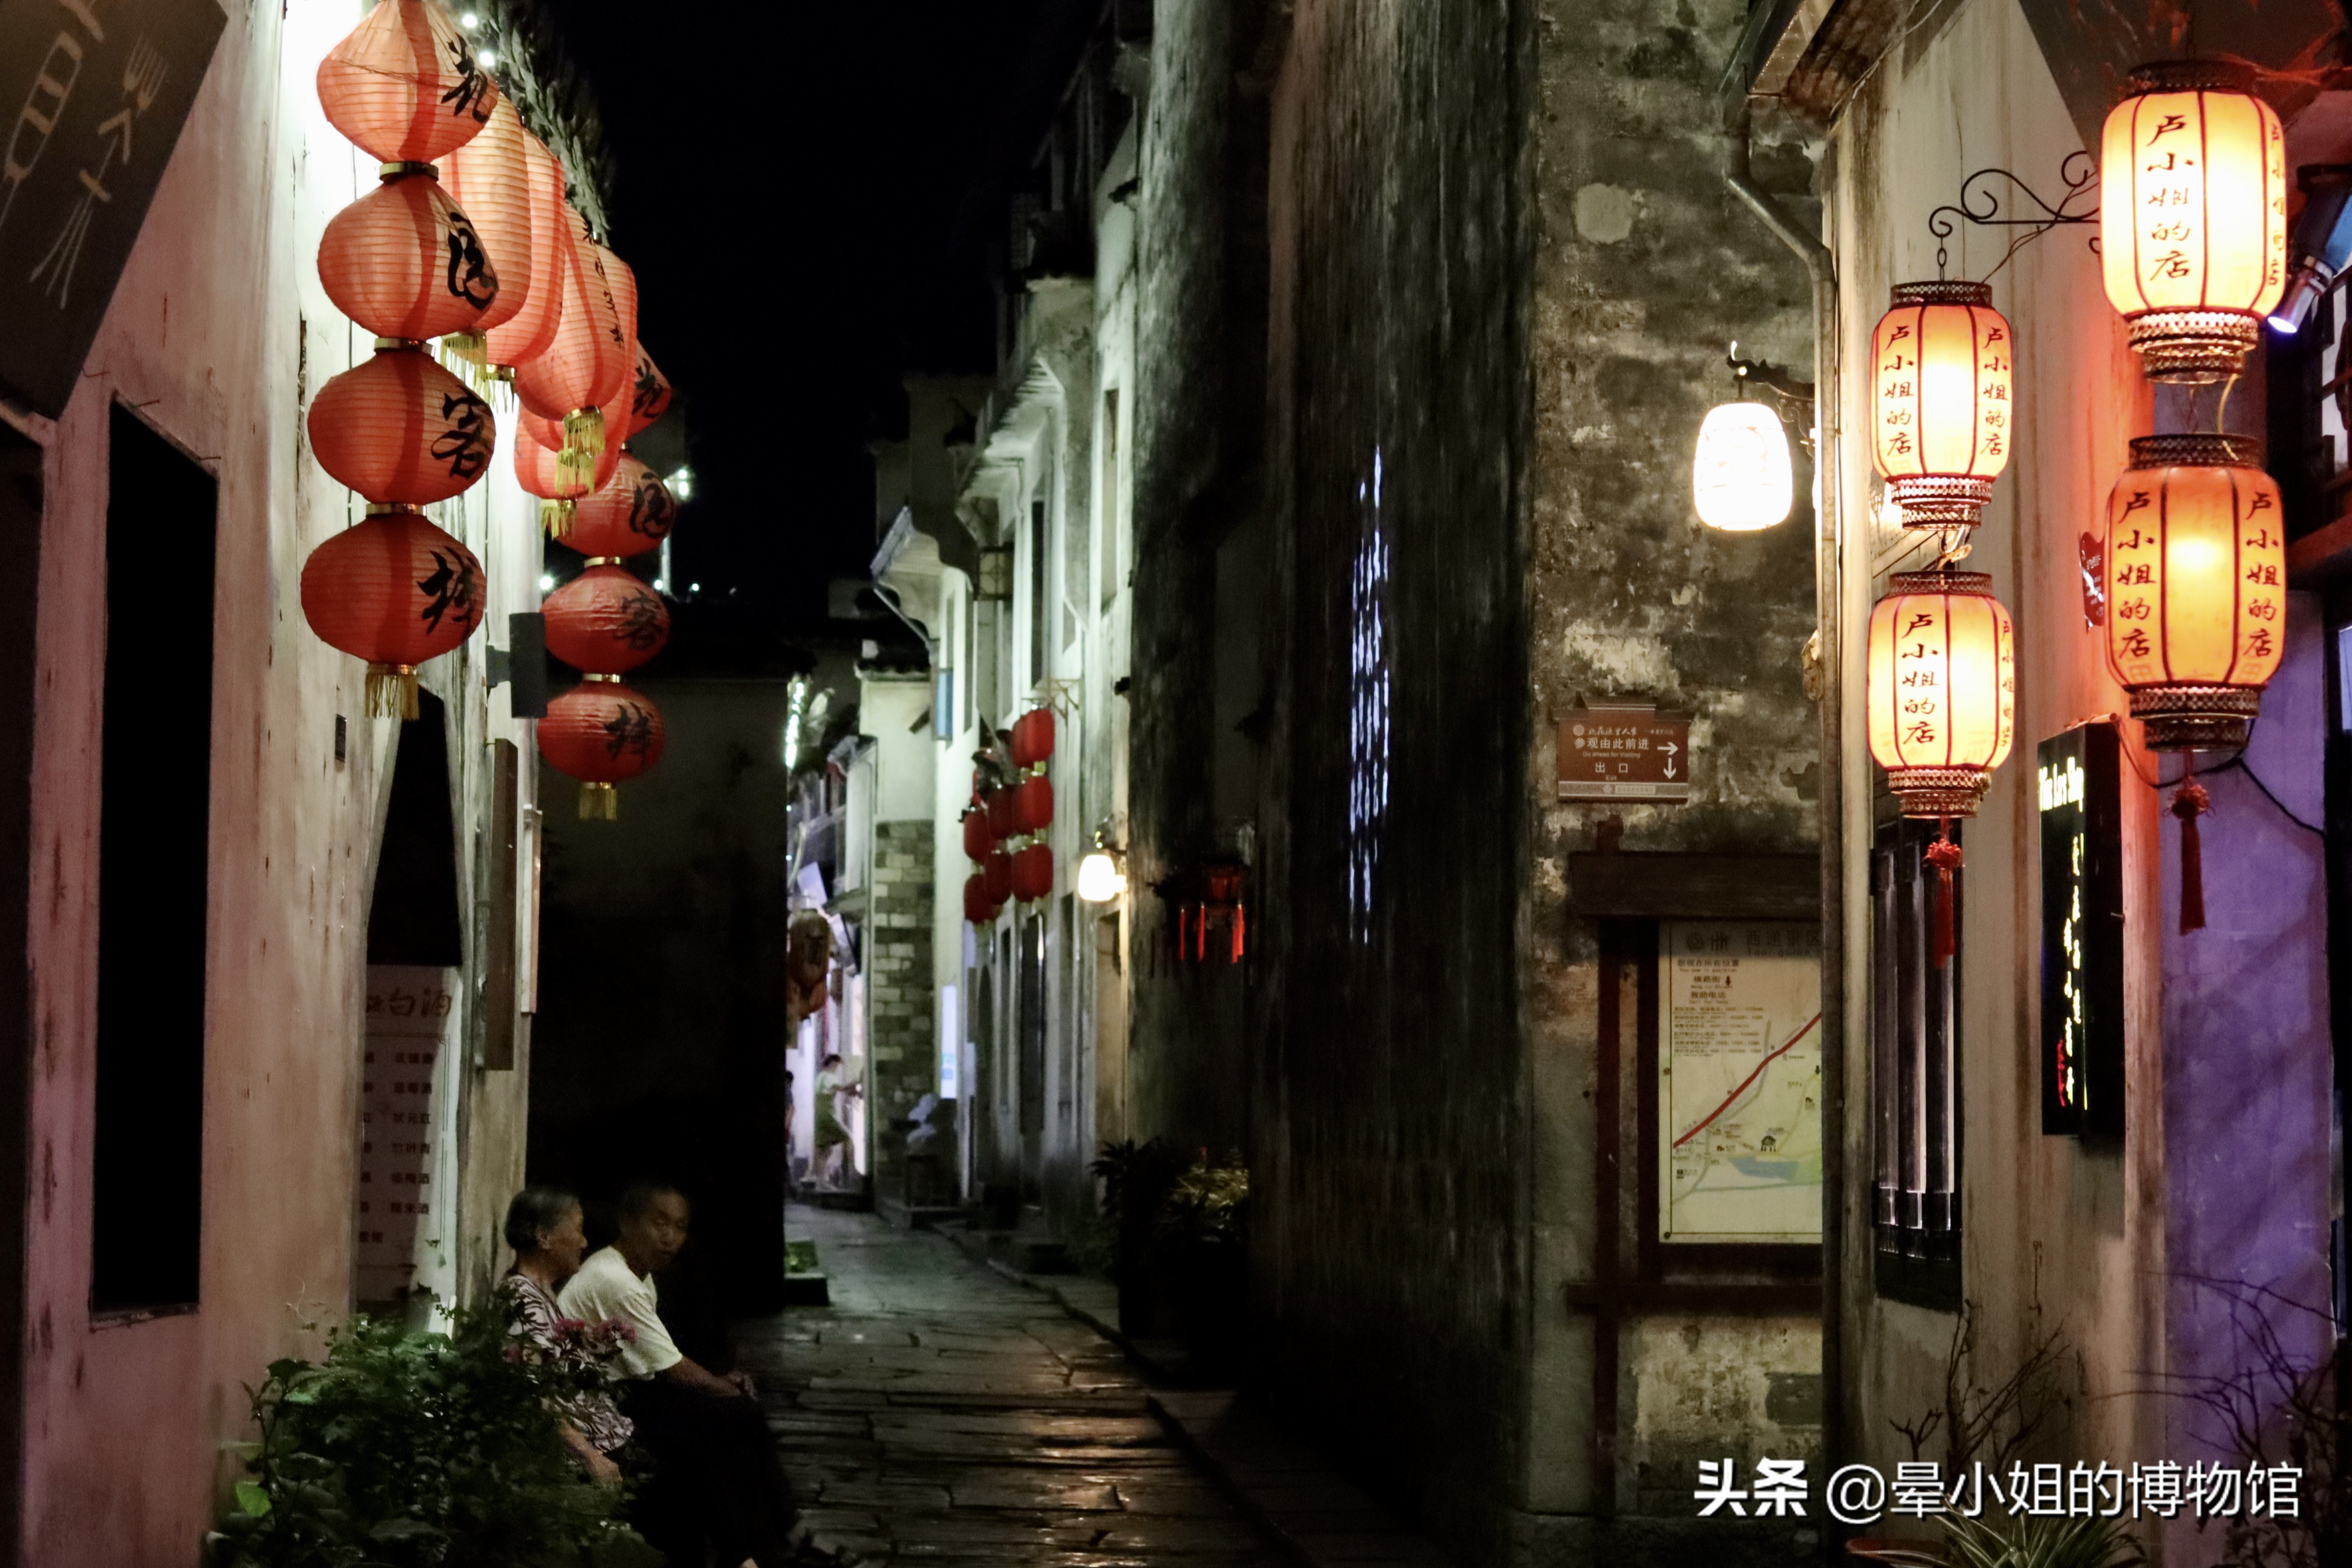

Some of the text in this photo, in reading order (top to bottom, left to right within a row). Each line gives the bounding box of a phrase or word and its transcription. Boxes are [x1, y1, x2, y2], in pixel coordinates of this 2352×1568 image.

[2146, 115, 2193, 281] 卢小姐的店
[1884, 326, 1915, 456] 卢小姐的店
[1980, 327, 2009, 456] 卢小姐的店
[2117, 492, 2156, 659] 卢小姐的店
[2246, 492, 2280, 658] 卢小姐的店
[1575, 737, 1649, 750] 参观由此前进
[1902, 614, 1940, 744] 卢小姐的店
[1595, 762, 1628, 773] 出口
